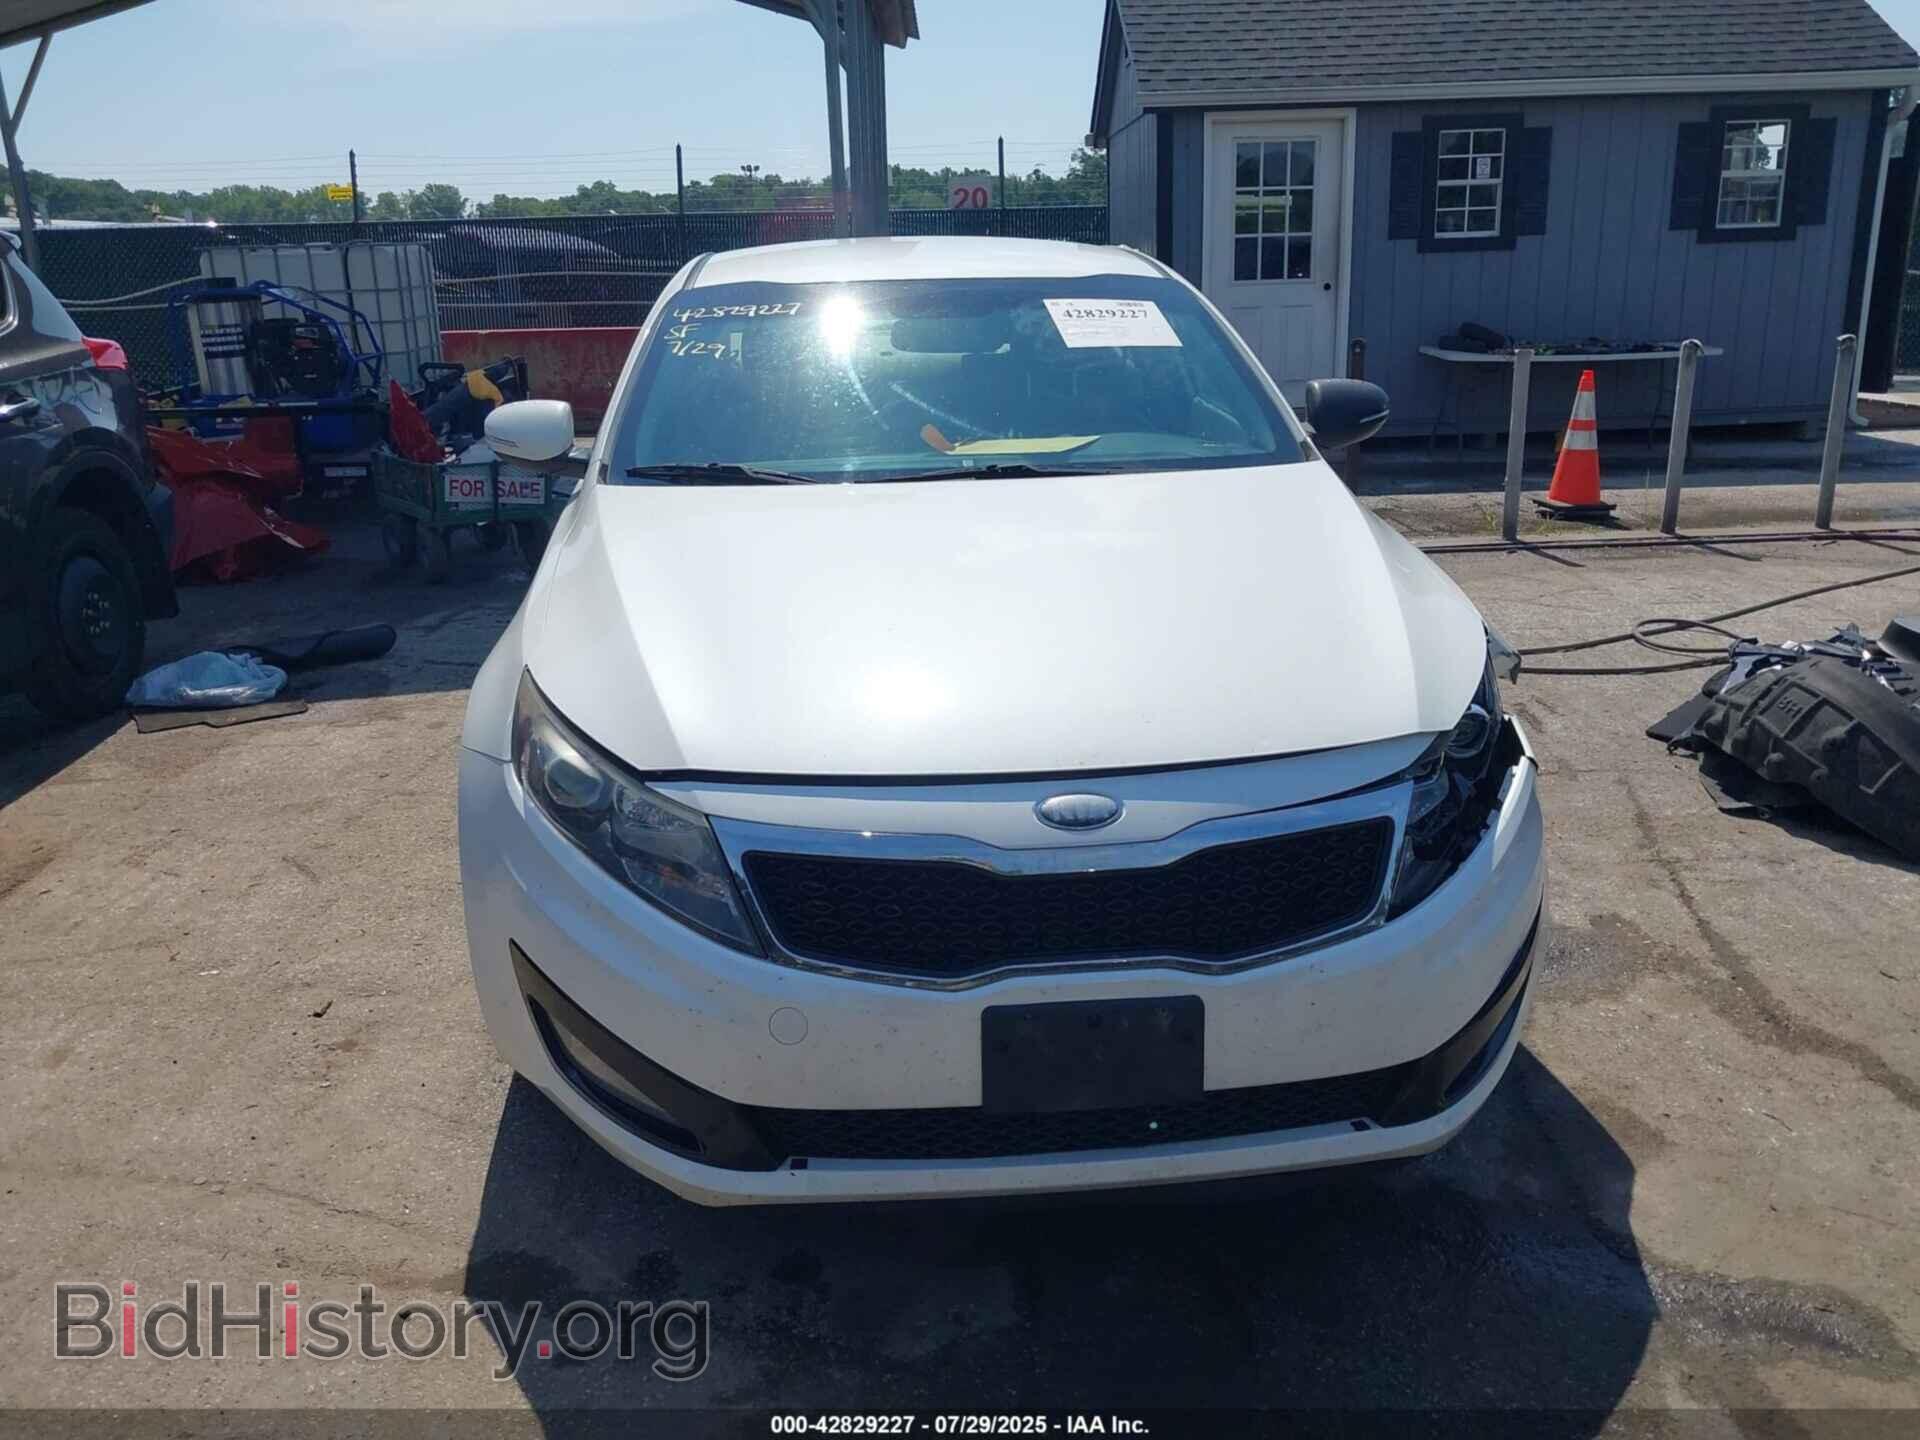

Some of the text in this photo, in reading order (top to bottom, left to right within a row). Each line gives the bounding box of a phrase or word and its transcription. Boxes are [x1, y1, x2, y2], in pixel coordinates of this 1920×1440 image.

[953, 186, 988, 208] 20
[673, 302, 801, 322] 42829227
[1063, 309, 1148, 319] 42829227
[666, 340, 726, 359] 7/29
[449, 480, 541, 498] FOR SALE
